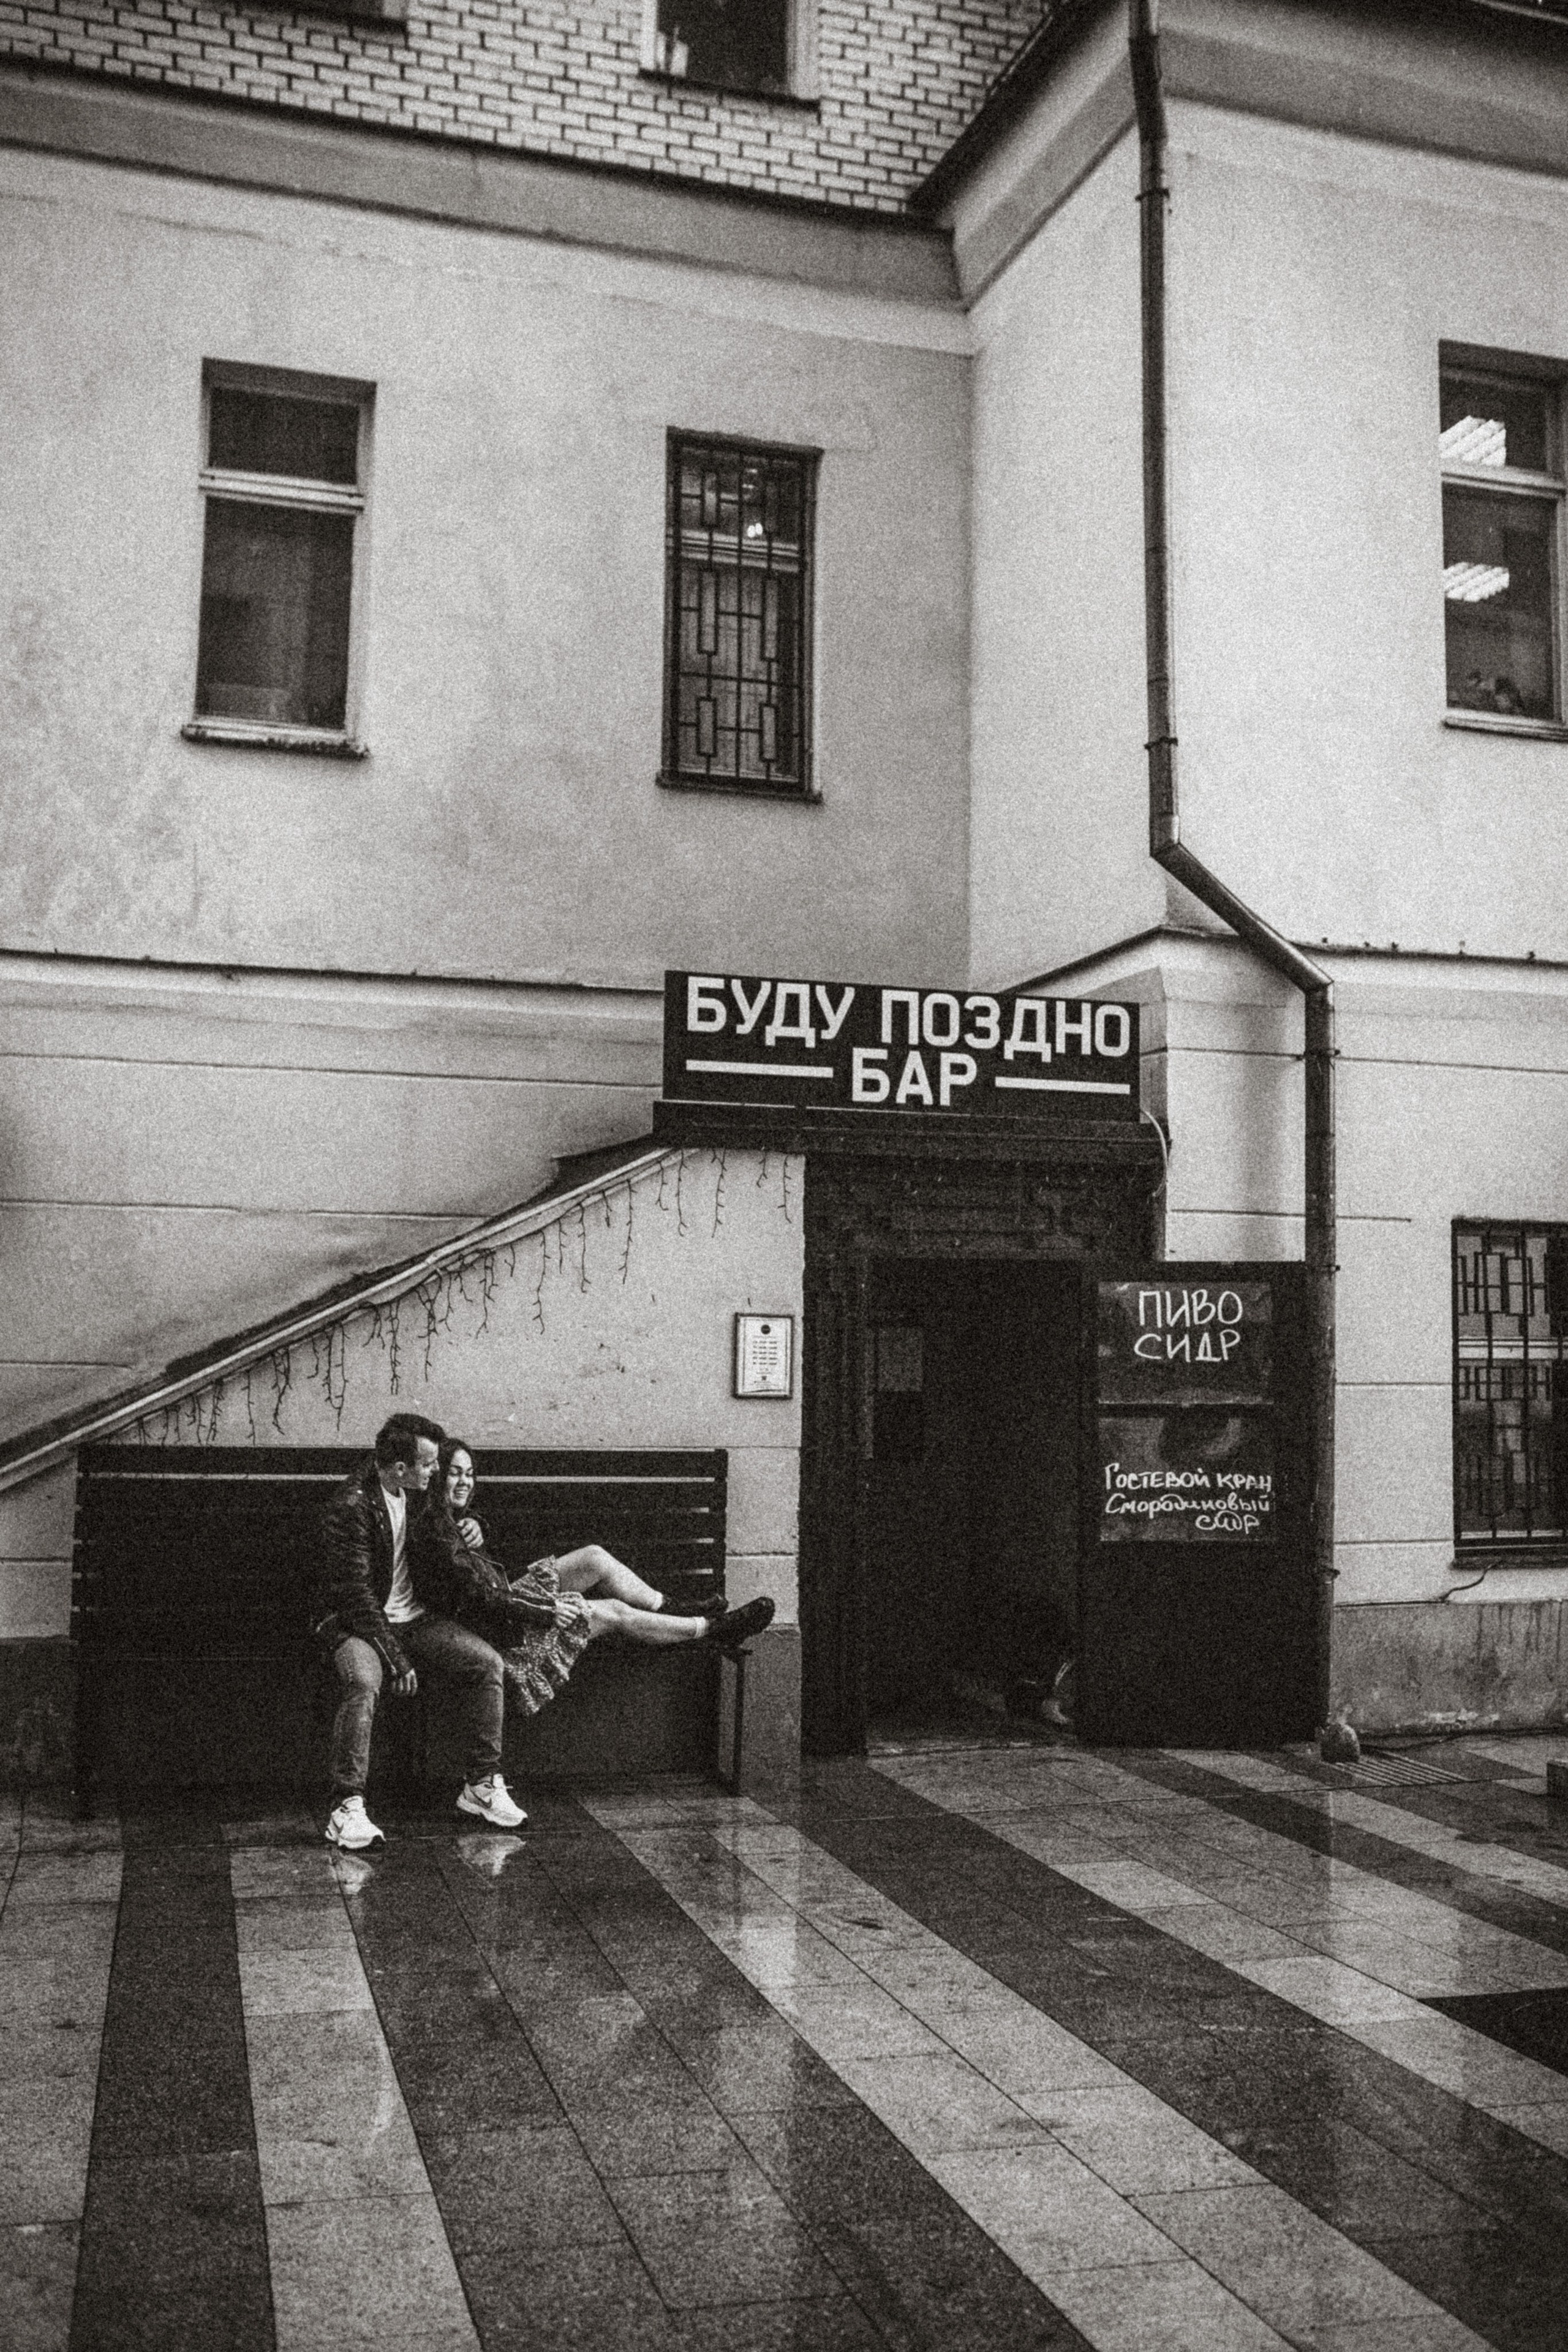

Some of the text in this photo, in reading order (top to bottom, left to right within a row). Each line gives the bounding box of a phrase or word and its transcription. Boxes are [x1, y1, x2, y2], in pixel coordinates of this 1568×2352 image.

[687, 976, 1131, 1063] БУДУ ПОЗДНО
[851, 1047, 978, 1106] БАР
[1139, 1289, 1243, 1328] ПИВО
[1134, 1329, 1241, 1363] СИДР
[1104, 1491, 1270, 1520] Смородиновый
